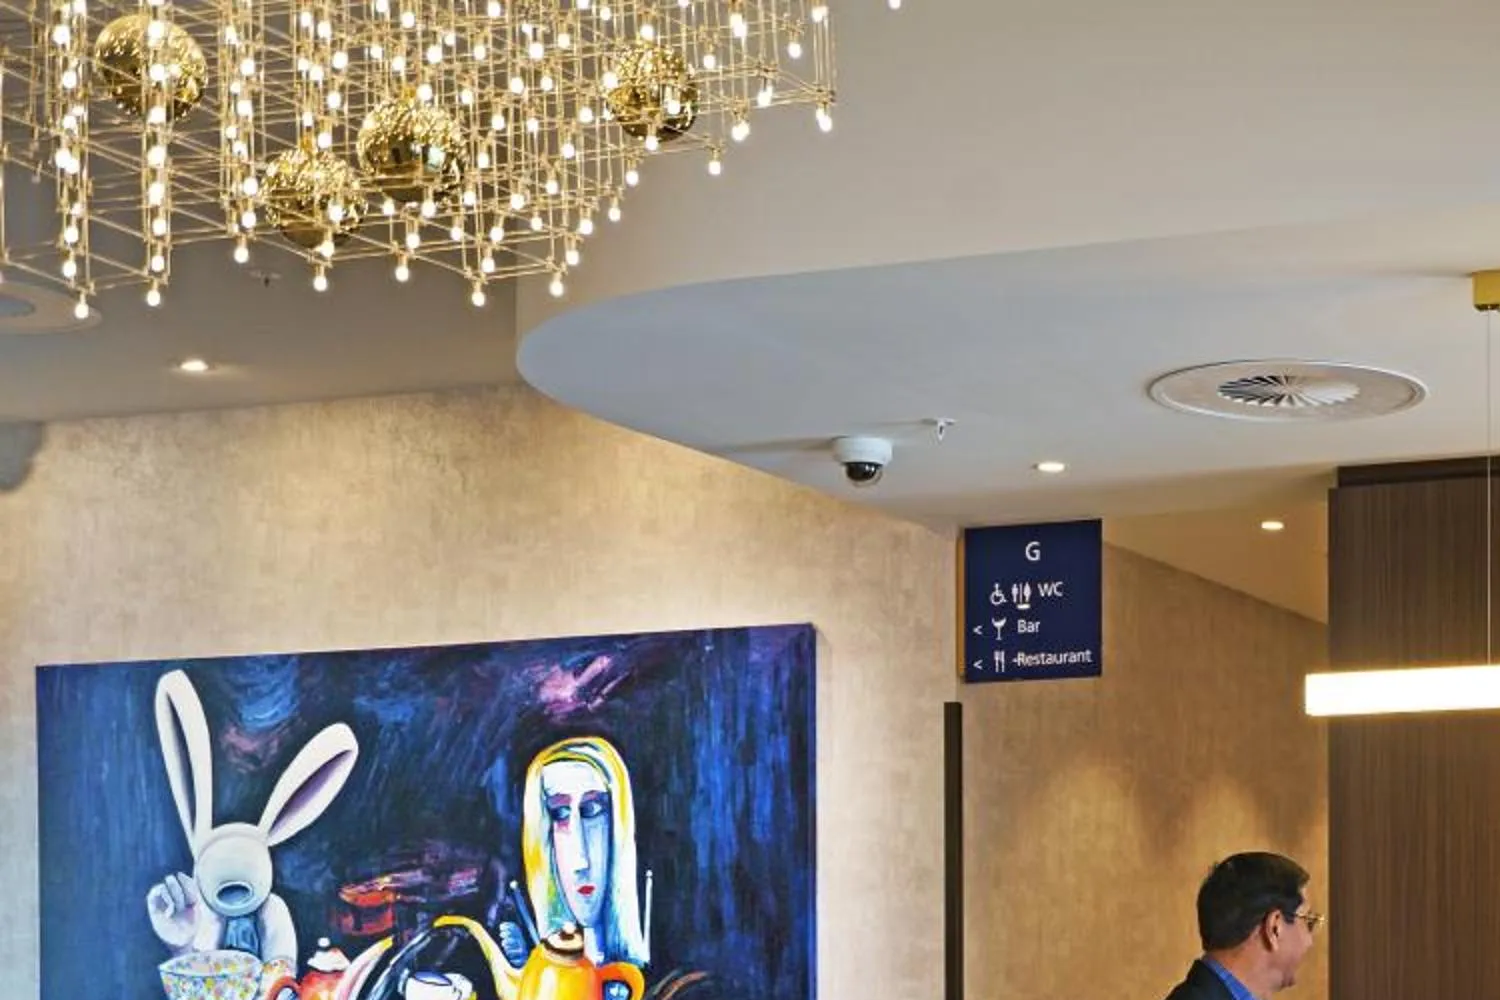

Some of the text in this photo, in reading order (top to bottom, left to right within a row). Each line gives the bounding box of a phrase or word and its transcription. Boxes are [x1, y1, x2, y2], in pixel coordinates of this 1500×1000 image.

[1025, 541, 1041, 561] G
[1037, 581, 1064, 597] WC
[1017, 619, 1041, 633] Bar
